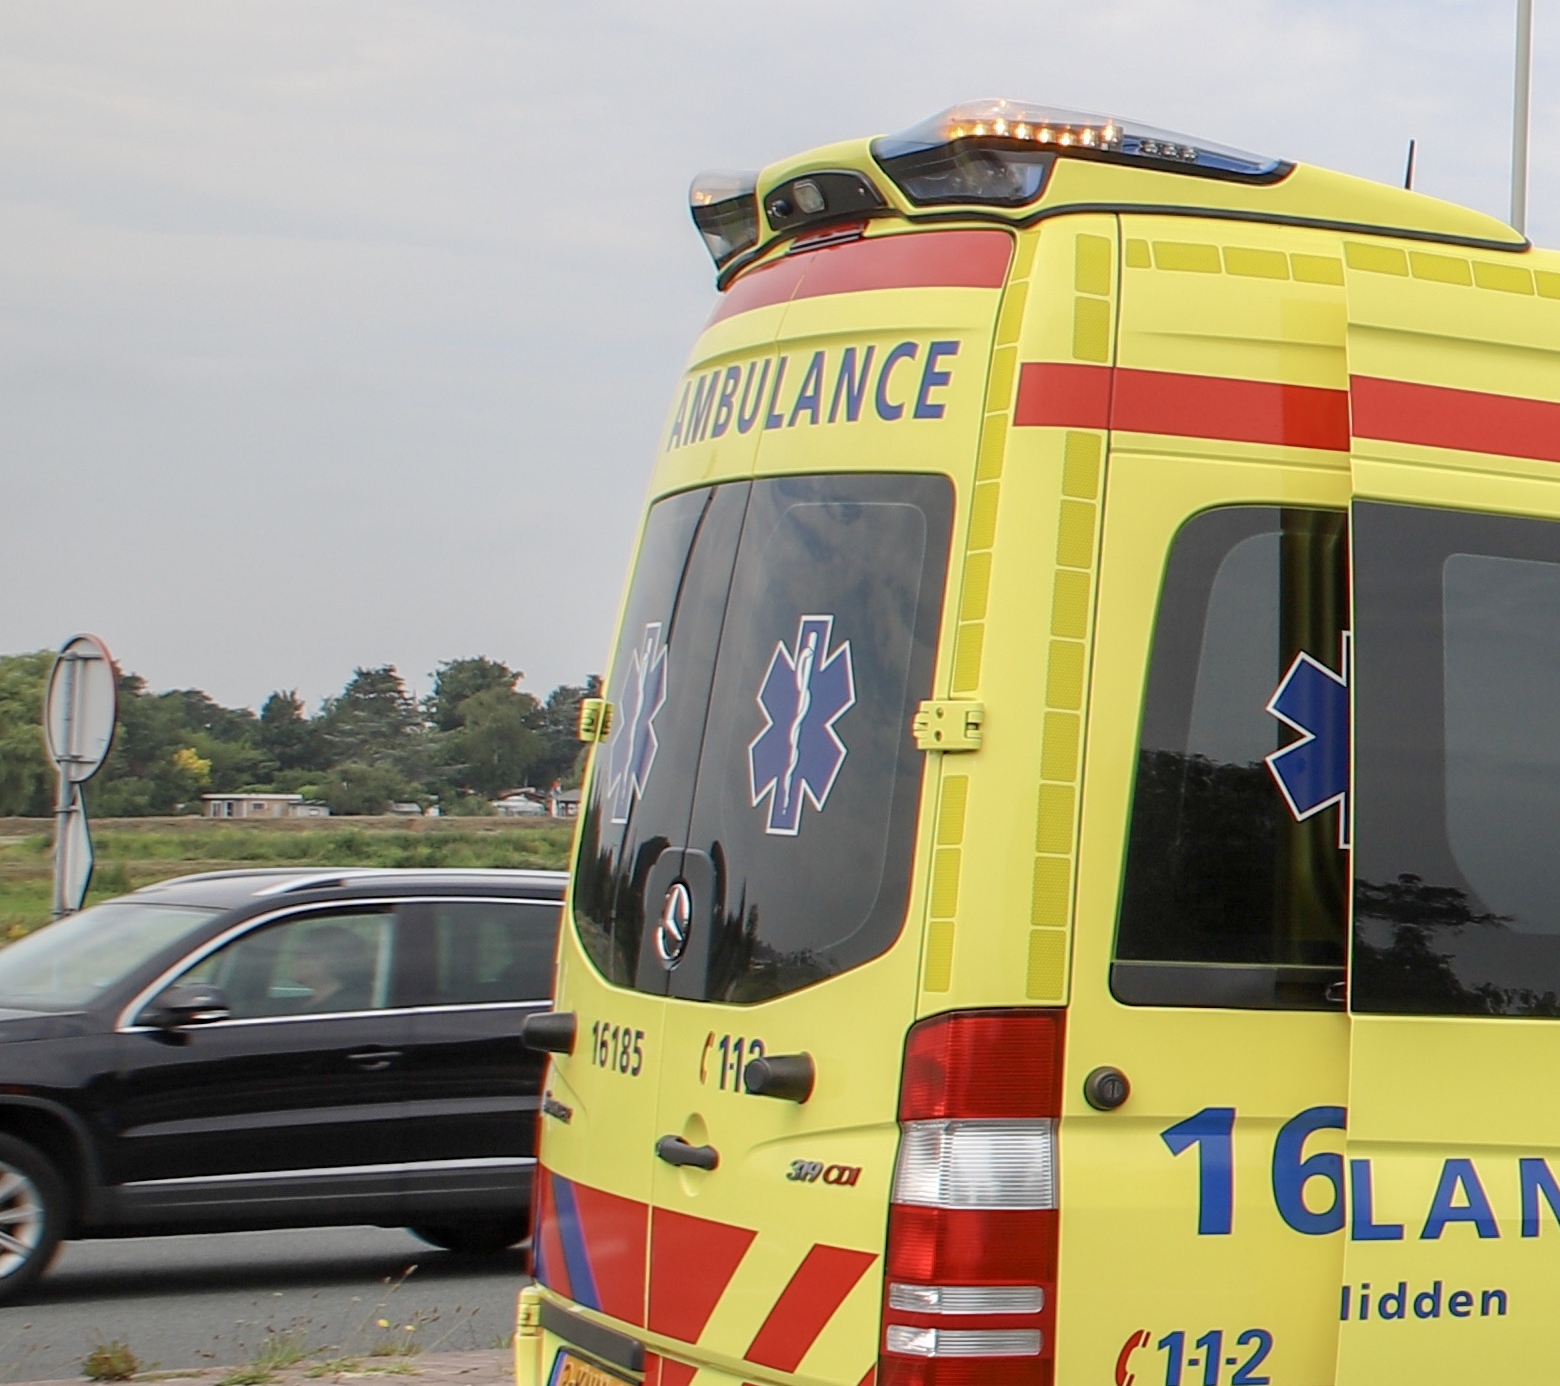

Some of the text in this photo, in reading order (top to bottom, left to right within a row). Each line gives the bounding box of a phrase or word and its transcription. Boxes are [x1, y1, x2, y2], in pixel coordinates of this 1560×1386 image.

[667, 339, 960, 452] AMBULANCE
[592, 1020, 646, 1076] 16185
[786, 1159, 863, 1186] 319 CDI
[1160, 1106, 1347, 1236] 16
